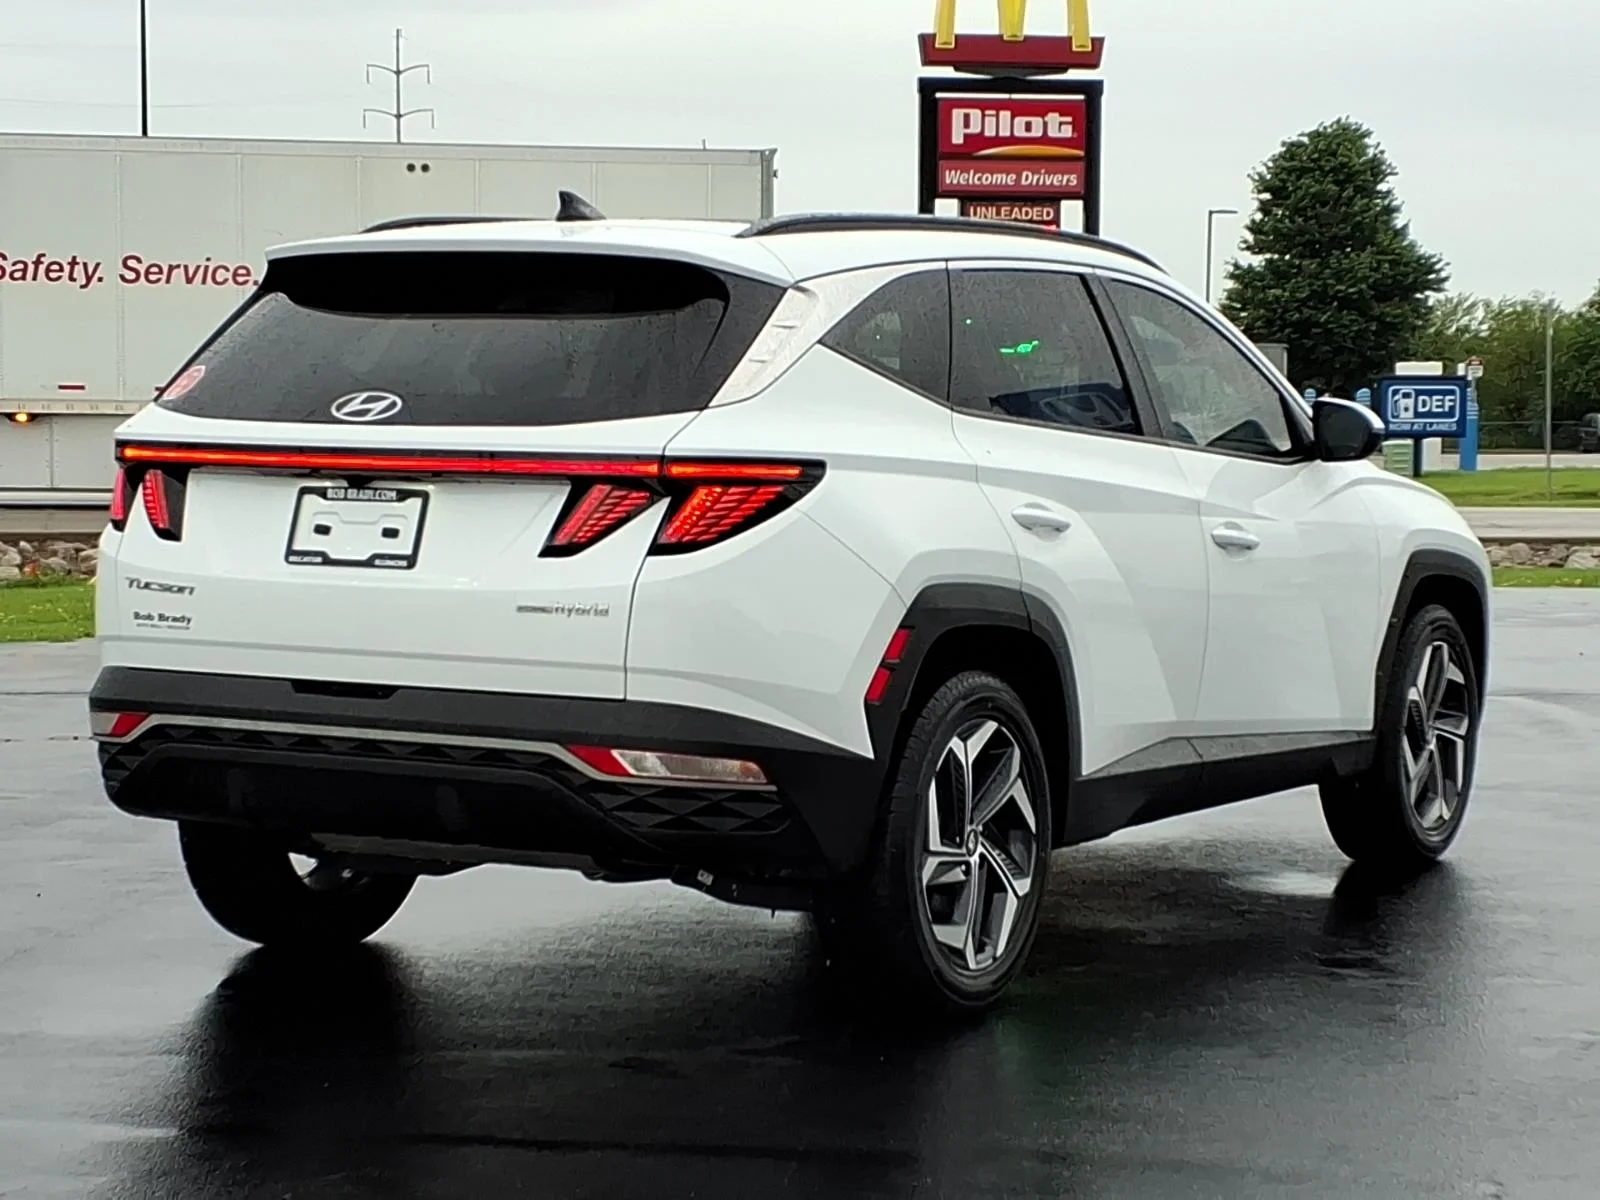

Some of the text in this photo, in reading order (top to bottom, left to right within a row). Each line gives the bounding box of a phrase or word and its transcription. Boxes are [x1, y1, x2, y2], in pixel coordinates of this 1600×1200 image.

[951, 108, 1073, 144] Pilot
[945, 169, 1077, 186] Welcome Drivers
[969, 206, 1054, 220] UNLEADED
[119, 255, 259, 286] Service.
[1417, 396, 1455, 412] DEF
[133, 611, 192, 625] Bob Brady
